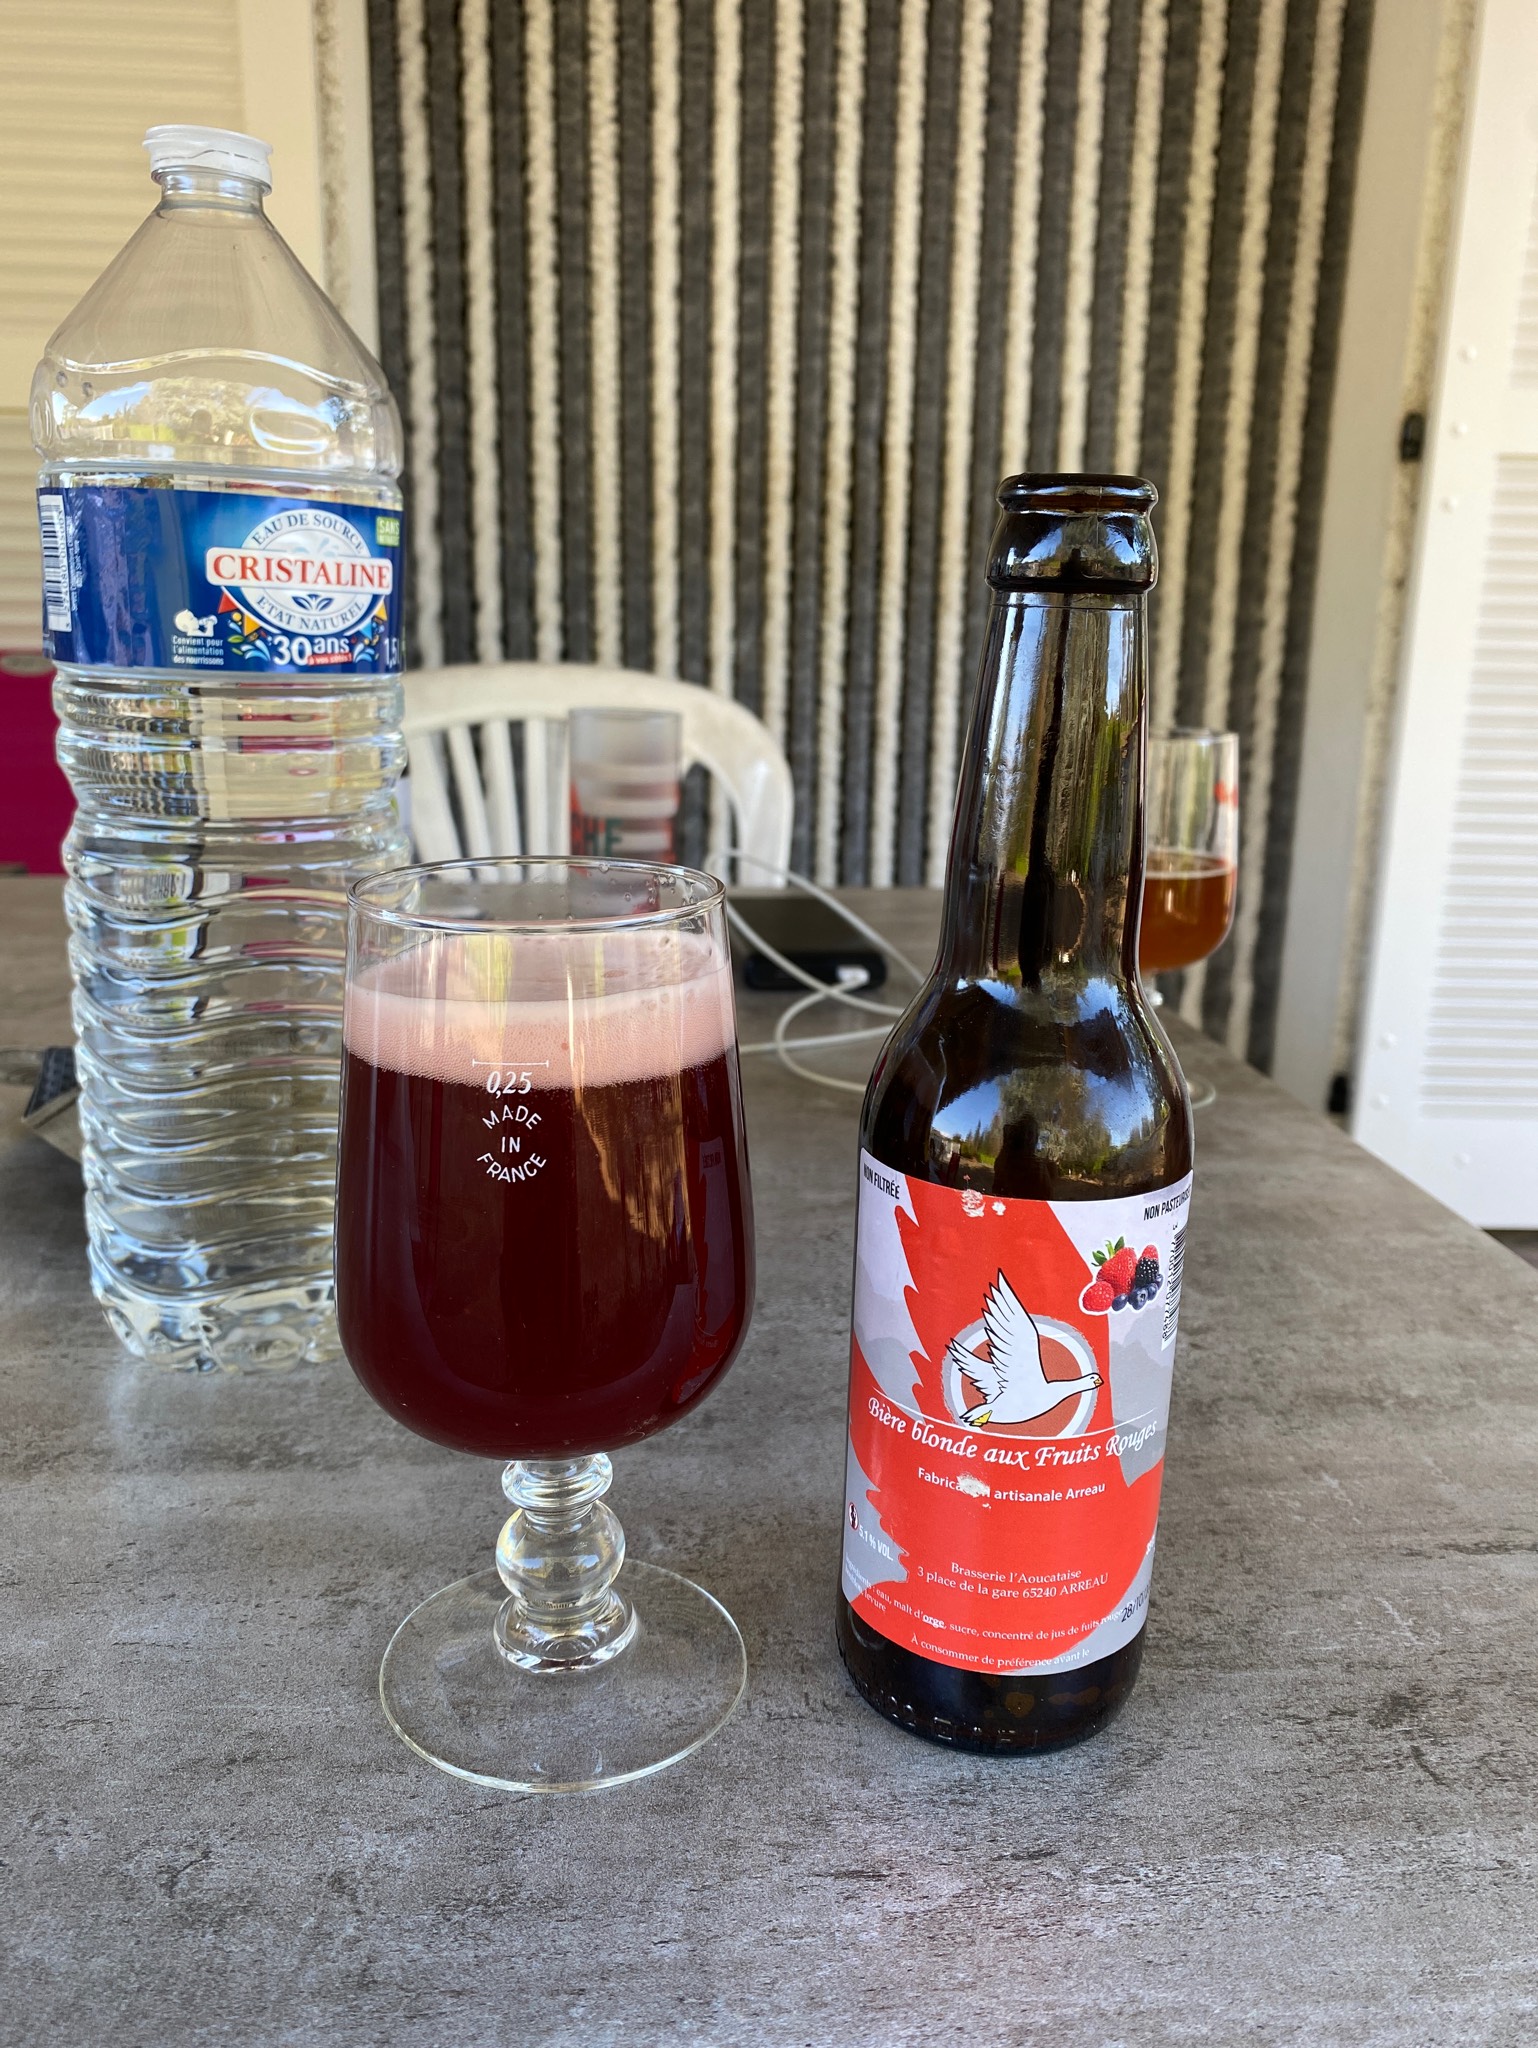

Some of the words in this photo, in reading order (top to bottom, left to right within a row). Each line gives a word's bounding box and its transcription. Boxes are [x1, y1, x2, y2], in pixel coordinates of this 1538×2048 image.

[252, 518, 283, 546] EAU
[286, 513, 310, 527] DE
[313, 514, 364, 555] SOURCE
[213, 554, 391, 589] CRISTALINE
[300, 602, 365, 631] NATUREL
[172, 635, 204, 645] Convient
[206, 638, 223, 647] pour
[173, 645, 224, 656] l'alimentation
[273, 635, 312, 666] 30
[313, 637, 349, 654] ans
[173, 655, 185, 664] des
[186, 656, 224, 666] nourrissons
[486, 1070, 533, 1099] 0,25
[482, 1104, 542, 1130] MADE
[501, 1136, 521, 1153] IN
[476, 1152, 547, 1183] FRANCE
[863, 1162, 874, 1184] NON
[874, 1172, 901, 1200] FILTRÉE
[1143, 1204, 1161, 1221] NON
[1161, 1184, 1191, 1216] PASTEURIS
[868, 1397, 907, 1433] Bière
[911, 1420, 978, 1459] blonde
[983, 1448, 1031, 1471] aux
[1034, 1442, 1101, 1467] Fruits
[1105, 1420, 1158, 1457] Rouges
[918, 1466, 991, 1498] Fabrican
[994, 1489, 1063, 1503] artisanale
[1065, 1482, 1106, 1501] Arreau
[917, 1565, 924, 1577] 3
[926, 1569, 957, 1588] place
[959, 1579, 974, 1592] de
[977, 1581, 989, 1596] la
[992, 1587, 1020, 1600] gare
[1022, 1586, 1057, 1599] 65240
[1059, 1572, 1110, 1596] ARREAU
[951, 1561, 1006, 1583] Brasserie
[1009, 1568, 1083, 1585] l'Aoucataise
[864, 1588, 887, 1612] levure
[876, 1588, 892, 1605] eau,
[893, 1599, 913, 1616] malt
[913, 1610, 947, 1629] d'orge,
[949, 1623, 980, 1637] sucre,
[982, 1629, 1034, 1640] concentré
[1036, 1630, 1049, 1640] de
[1051, 1628, 1065, 1640] jus
[1067, 1626, 1079, 1634] de
[911, 1632, 919, 1646] À
[920, 1640, 980, 1663] consommer
[981, 1655, 995, 1665] de
[997, 1657, 1053, 1669] préférence
[1053, 1652, 1081, 1665] avant
[1082, 1648, 1090, 1659] le
